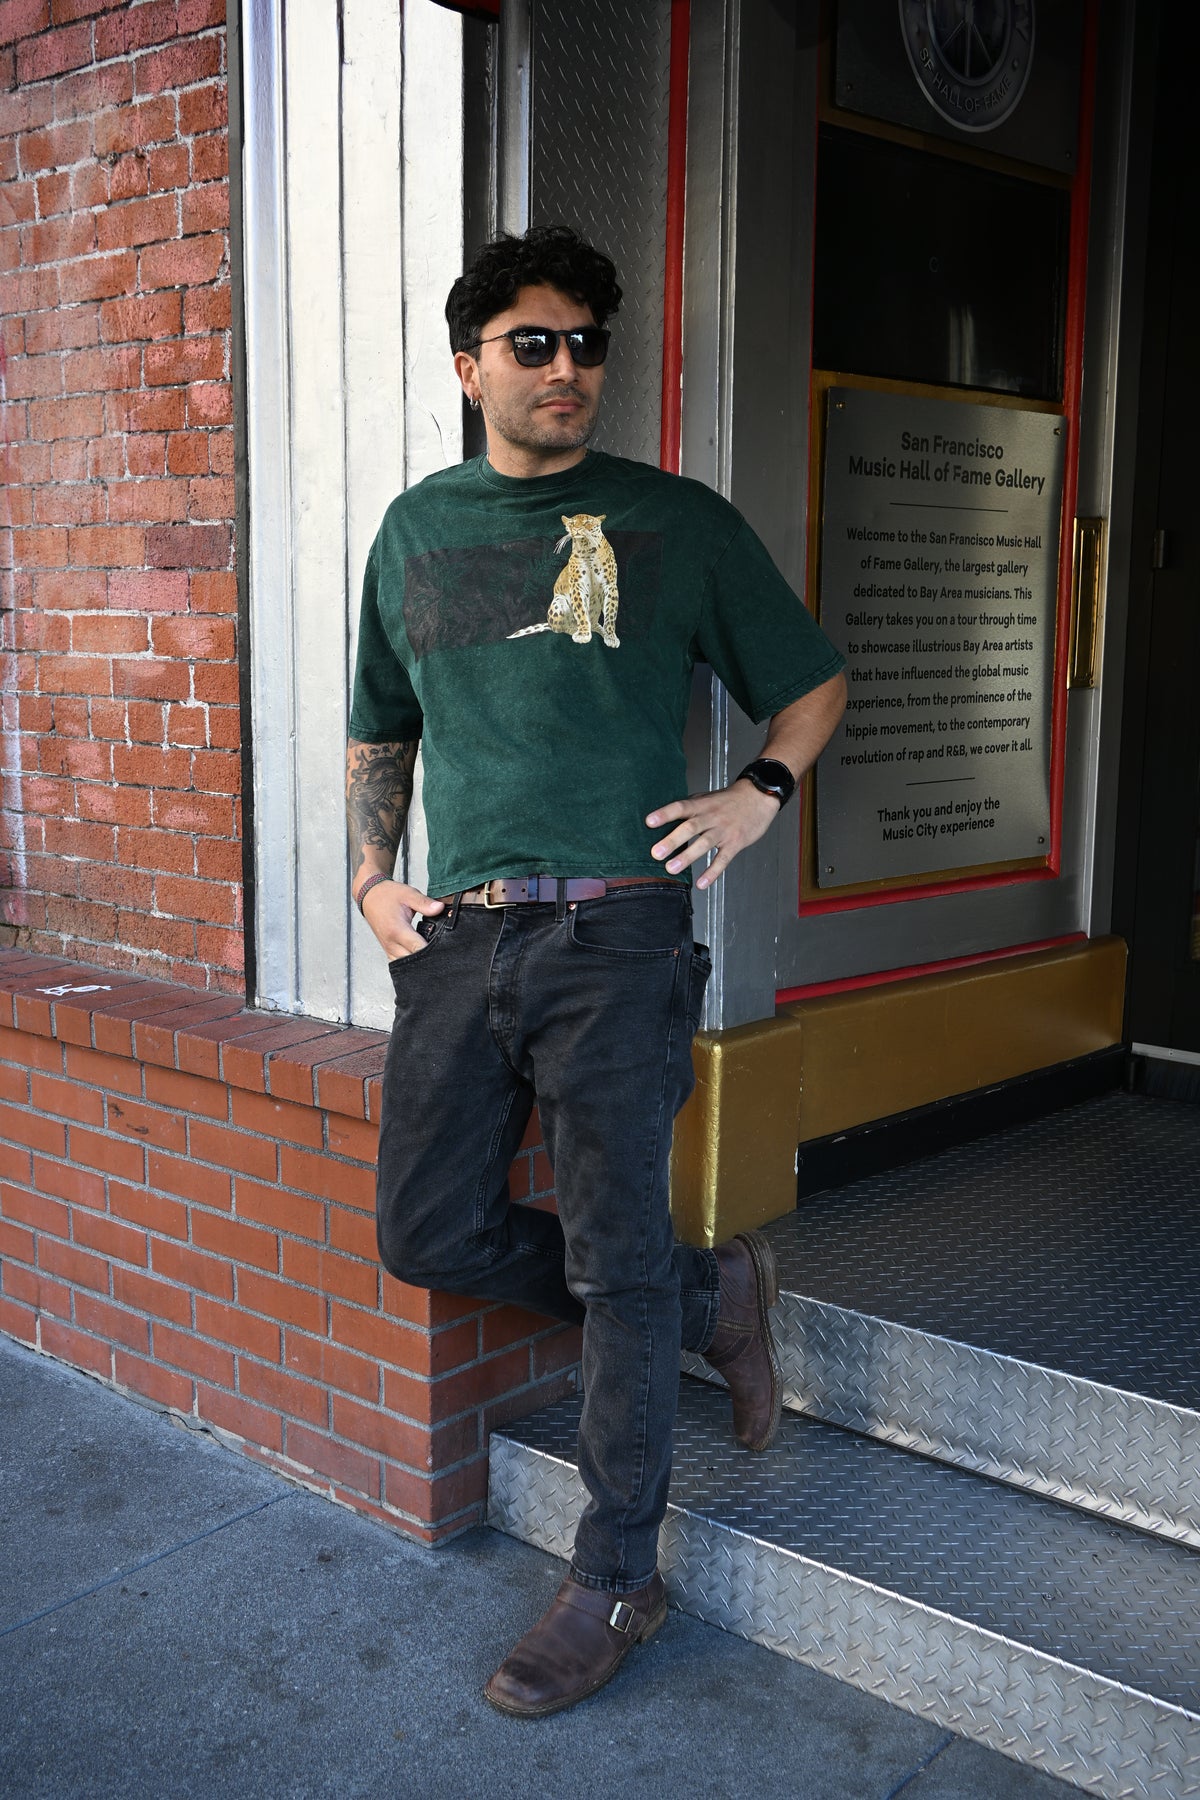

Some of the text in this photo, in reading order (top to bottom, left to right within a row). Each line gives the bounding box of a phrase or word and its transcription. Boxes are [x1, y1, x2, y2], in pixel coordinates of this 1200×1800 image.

[919, 48, 1012, 112] SF HALL OF FAME
[901, 432, 1003, 459] San Francisco
[849, 456, 1045, 495] Music Hall of Fame Gallery
[847, 528, 1041, 548] Welcome to the San Francisco Music Hall
[860, 556, 1028, 576] of Fame Gallery, the largest gallery
[853, 584, 1032, 601] dedicated to Bay Area musicians. This
[845, 612, 1037, 628] Gallery takes you on a tour through time
[848, 639, 1033, 654] to showcase illustrious Bay Area artists
[851, 665, 1029, 681] that have influenced the global music
[846, 689, 1032, 711] experience, from the prominence of the
[845, 717, 1030, 741] hippie movement, to the contemporary
[841, 740, 1032, 766] revolution of rap and R&B, we cover it all.
[877, 797, 1000, 823] Thank you and enjoy the
[882, 818, 995, 841] Music City experience
